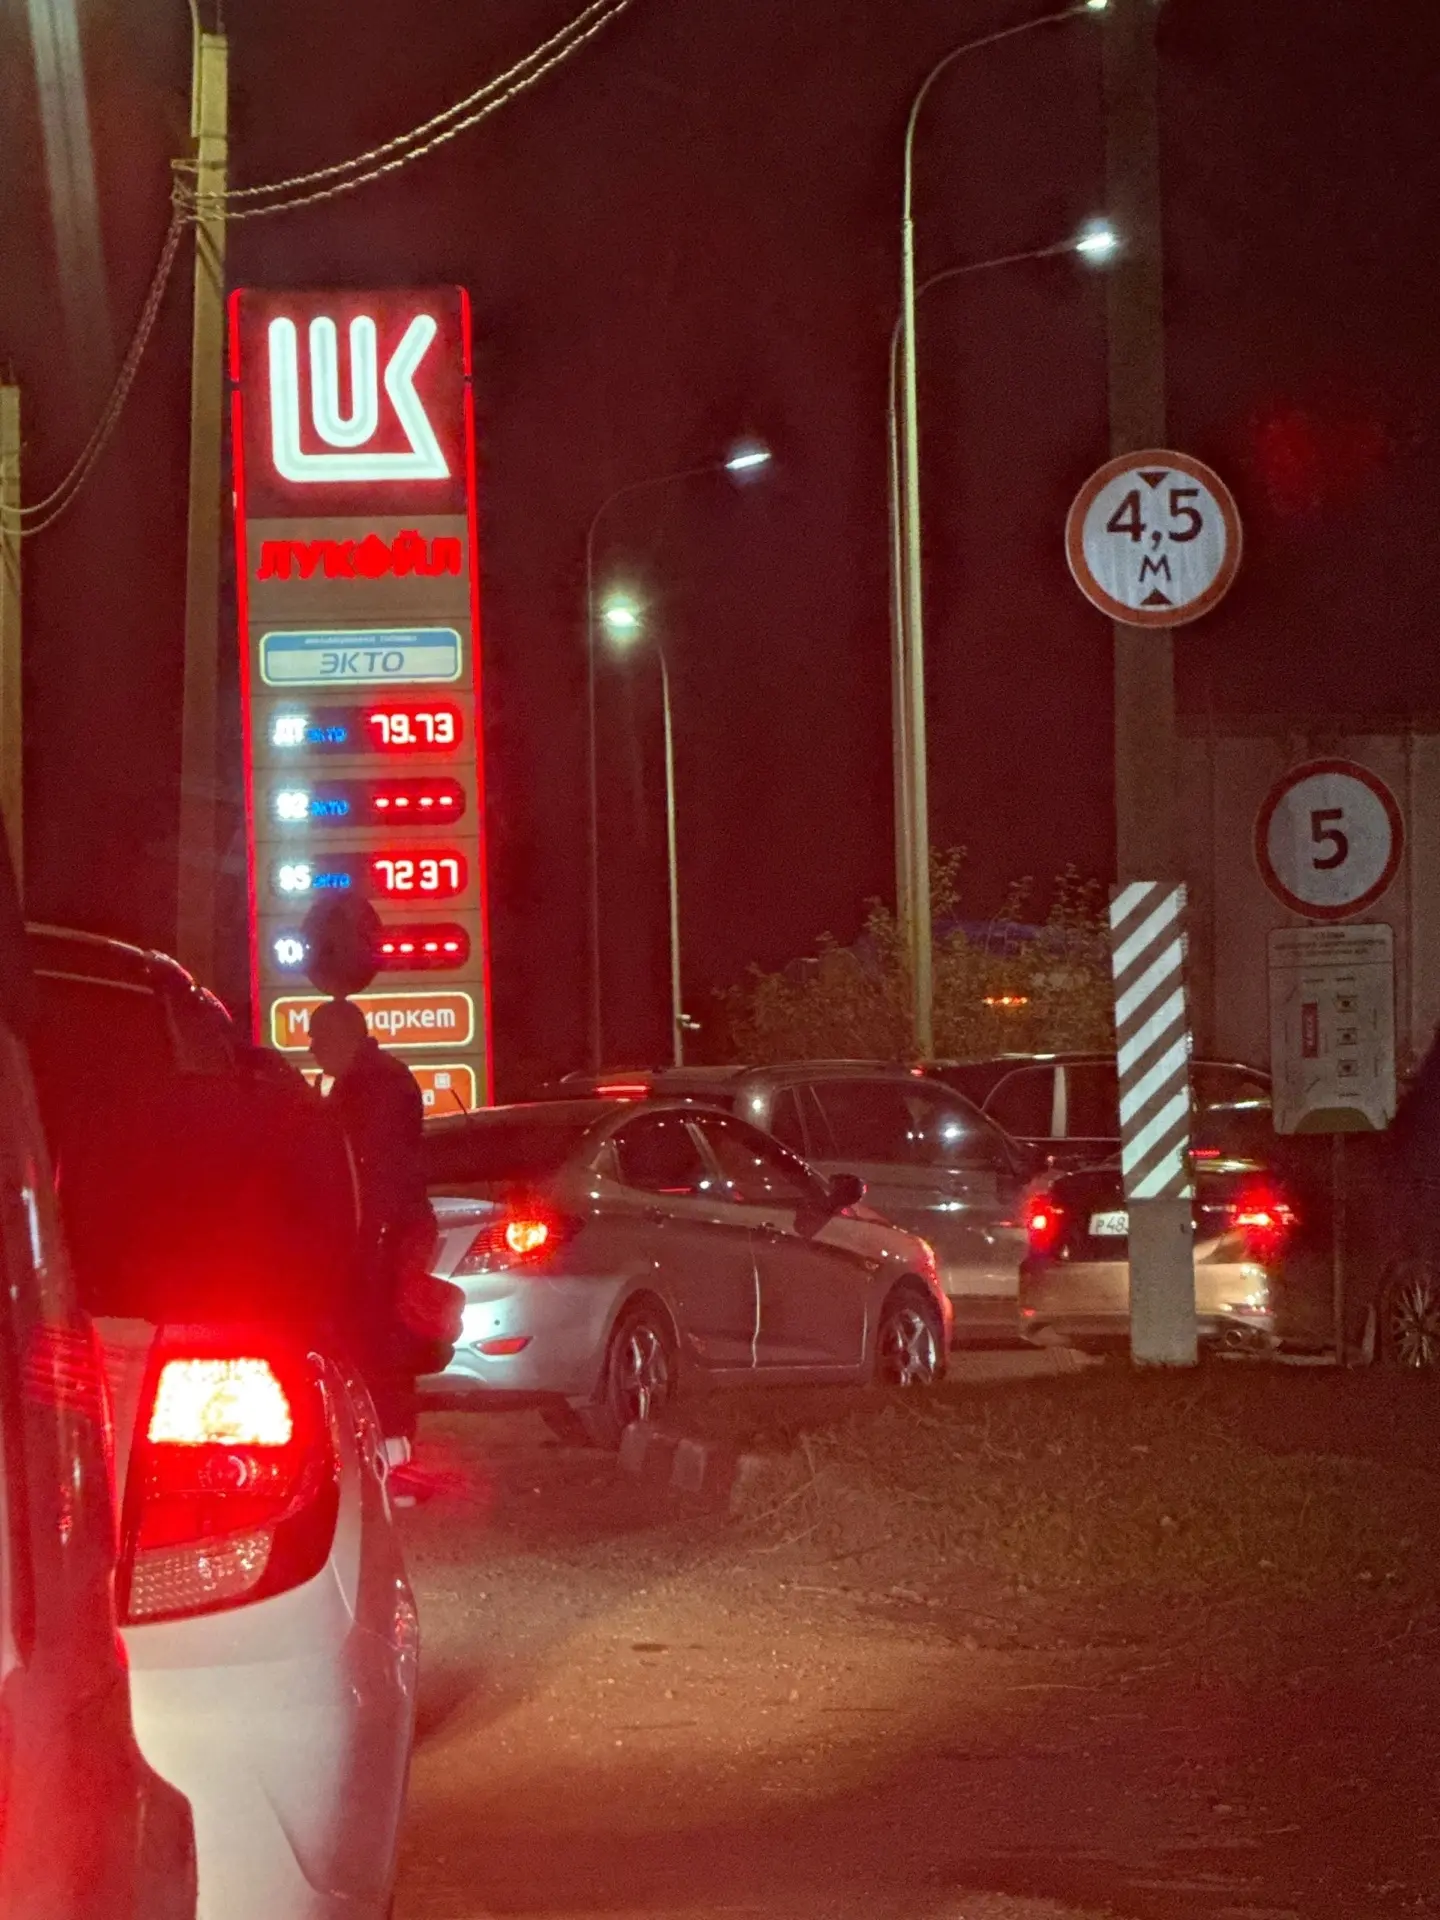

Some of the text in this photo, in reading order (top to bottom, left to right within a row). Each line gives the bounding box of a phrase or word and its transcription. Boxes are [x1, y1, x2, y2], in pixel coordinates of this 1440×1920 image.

[1106, 488, 1204, 551] 4,5
[256, 529, 462, 581] ЛУКОЙЛ
[320, 651, 405, 674] ЭКТО
[370, 712, 454, 745] 79.73
[1310, 807, 1349, 870] 5
